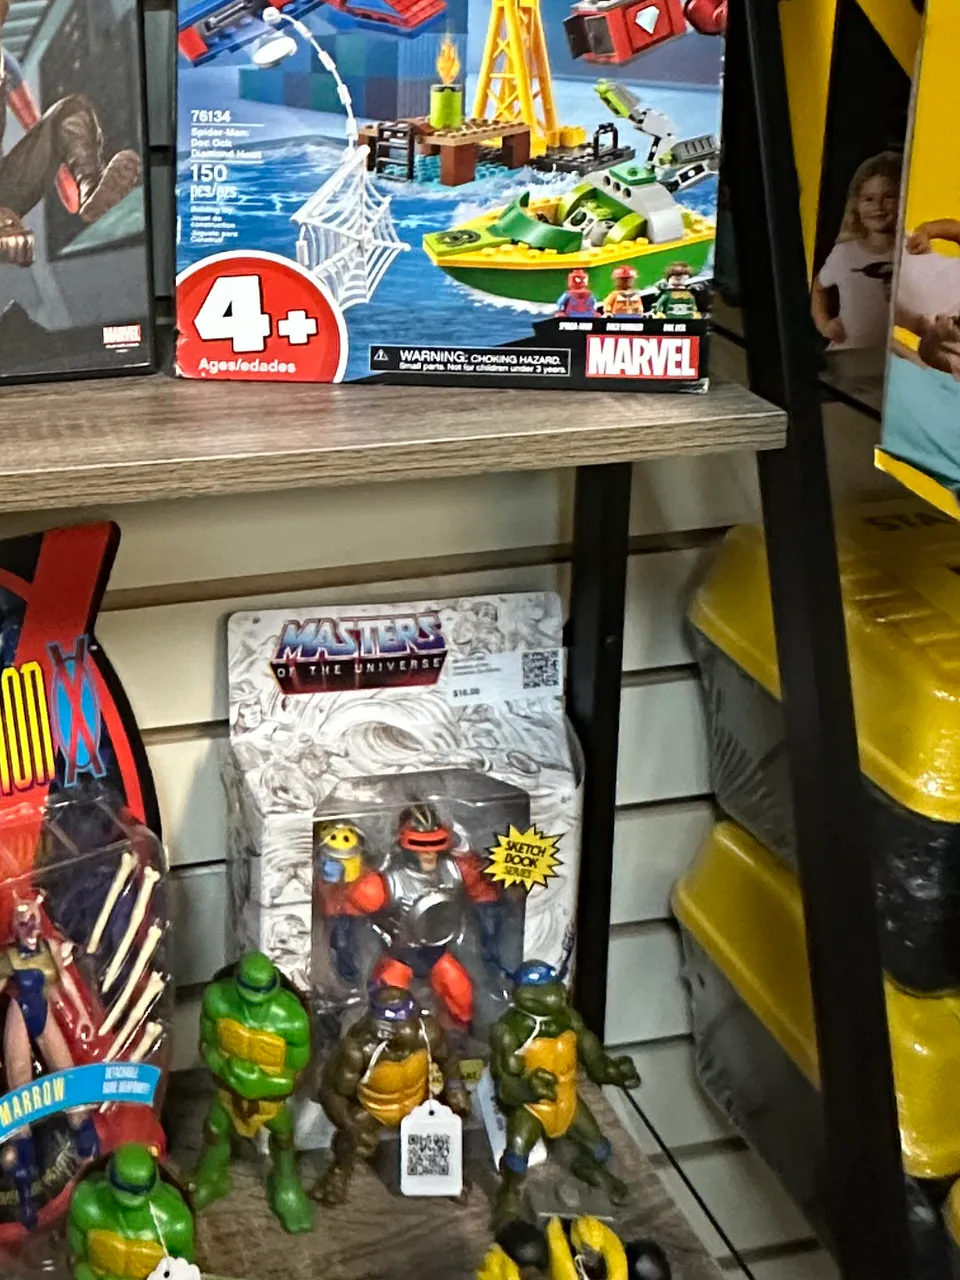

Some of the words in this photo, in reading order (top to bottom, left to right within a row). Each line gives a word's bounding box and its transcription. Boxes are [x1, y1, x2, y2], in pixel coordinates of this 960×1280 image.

[190, 109, 232, 123] 76134
[191, 139, 210, 148] Doc
[212, 139, 232, 148] Ock
[190, 164, 228, 182] 150
[193, 274, 318, 354] 4+
[399, 349, 469, 363] WARNING:
[470, 354, 518, 364] CHOKING
[588, 336, 696, 377] MARVEL
[198, 357, 296, 375] Ages/edades
[399, 362, 422, 370] Small
[447, 363, 462, 371] Not
[463, 363, 475, 371] for
[475, 363, 509, 372] children
[510, 365, 534, 373] under
[535, 365, 542, 373] 3
[274, 610, 447, 663] MASTERS
[277, 667, 295, 678] OF
[309, 664, 342, 675] THE
[354, 658, 441, 674] UNIVERSE
[505, 840, 547, 857] SKETCH
[504, 853, 539, 868] BOOK
[504, 866, 532, 878] SERIES
